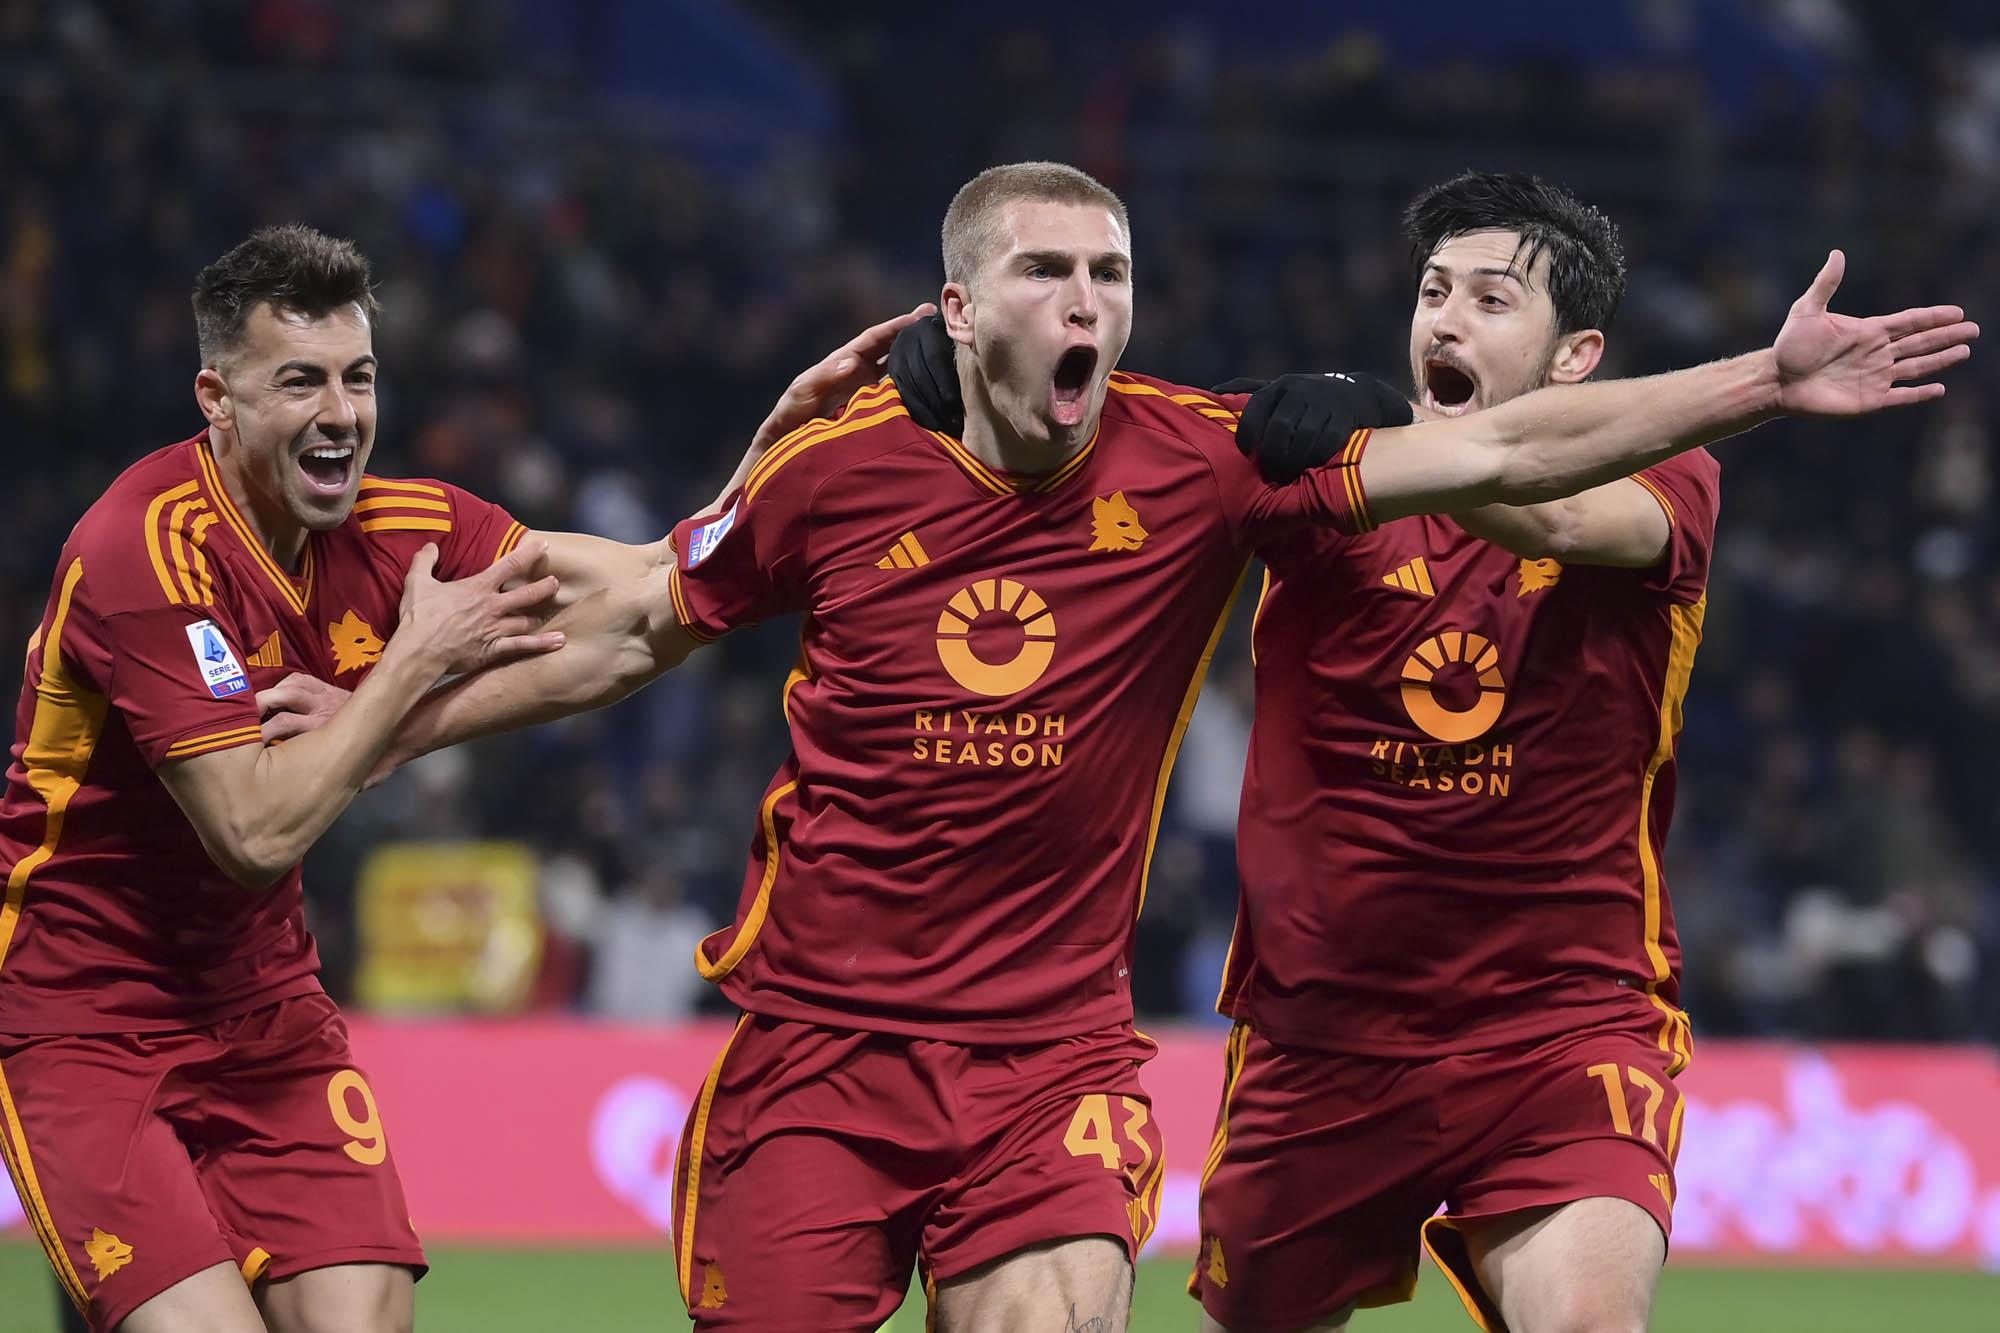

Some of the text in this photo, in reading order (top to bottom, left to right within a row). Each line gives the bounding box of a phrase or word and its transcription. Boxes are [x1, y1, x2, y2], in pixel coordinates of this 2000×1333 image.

[208, 664, 231, 678] SERIE
[226, 678, 246, 691] TIM
[915, 709, 1065, 737] RIYADH
[912, 737, 1063, 767] SEASON
[327, 1069, 387, 1166] 9
[1586, 1062, 1665, 1145] 17
[1063, 1093, 1153, 1188] 43
